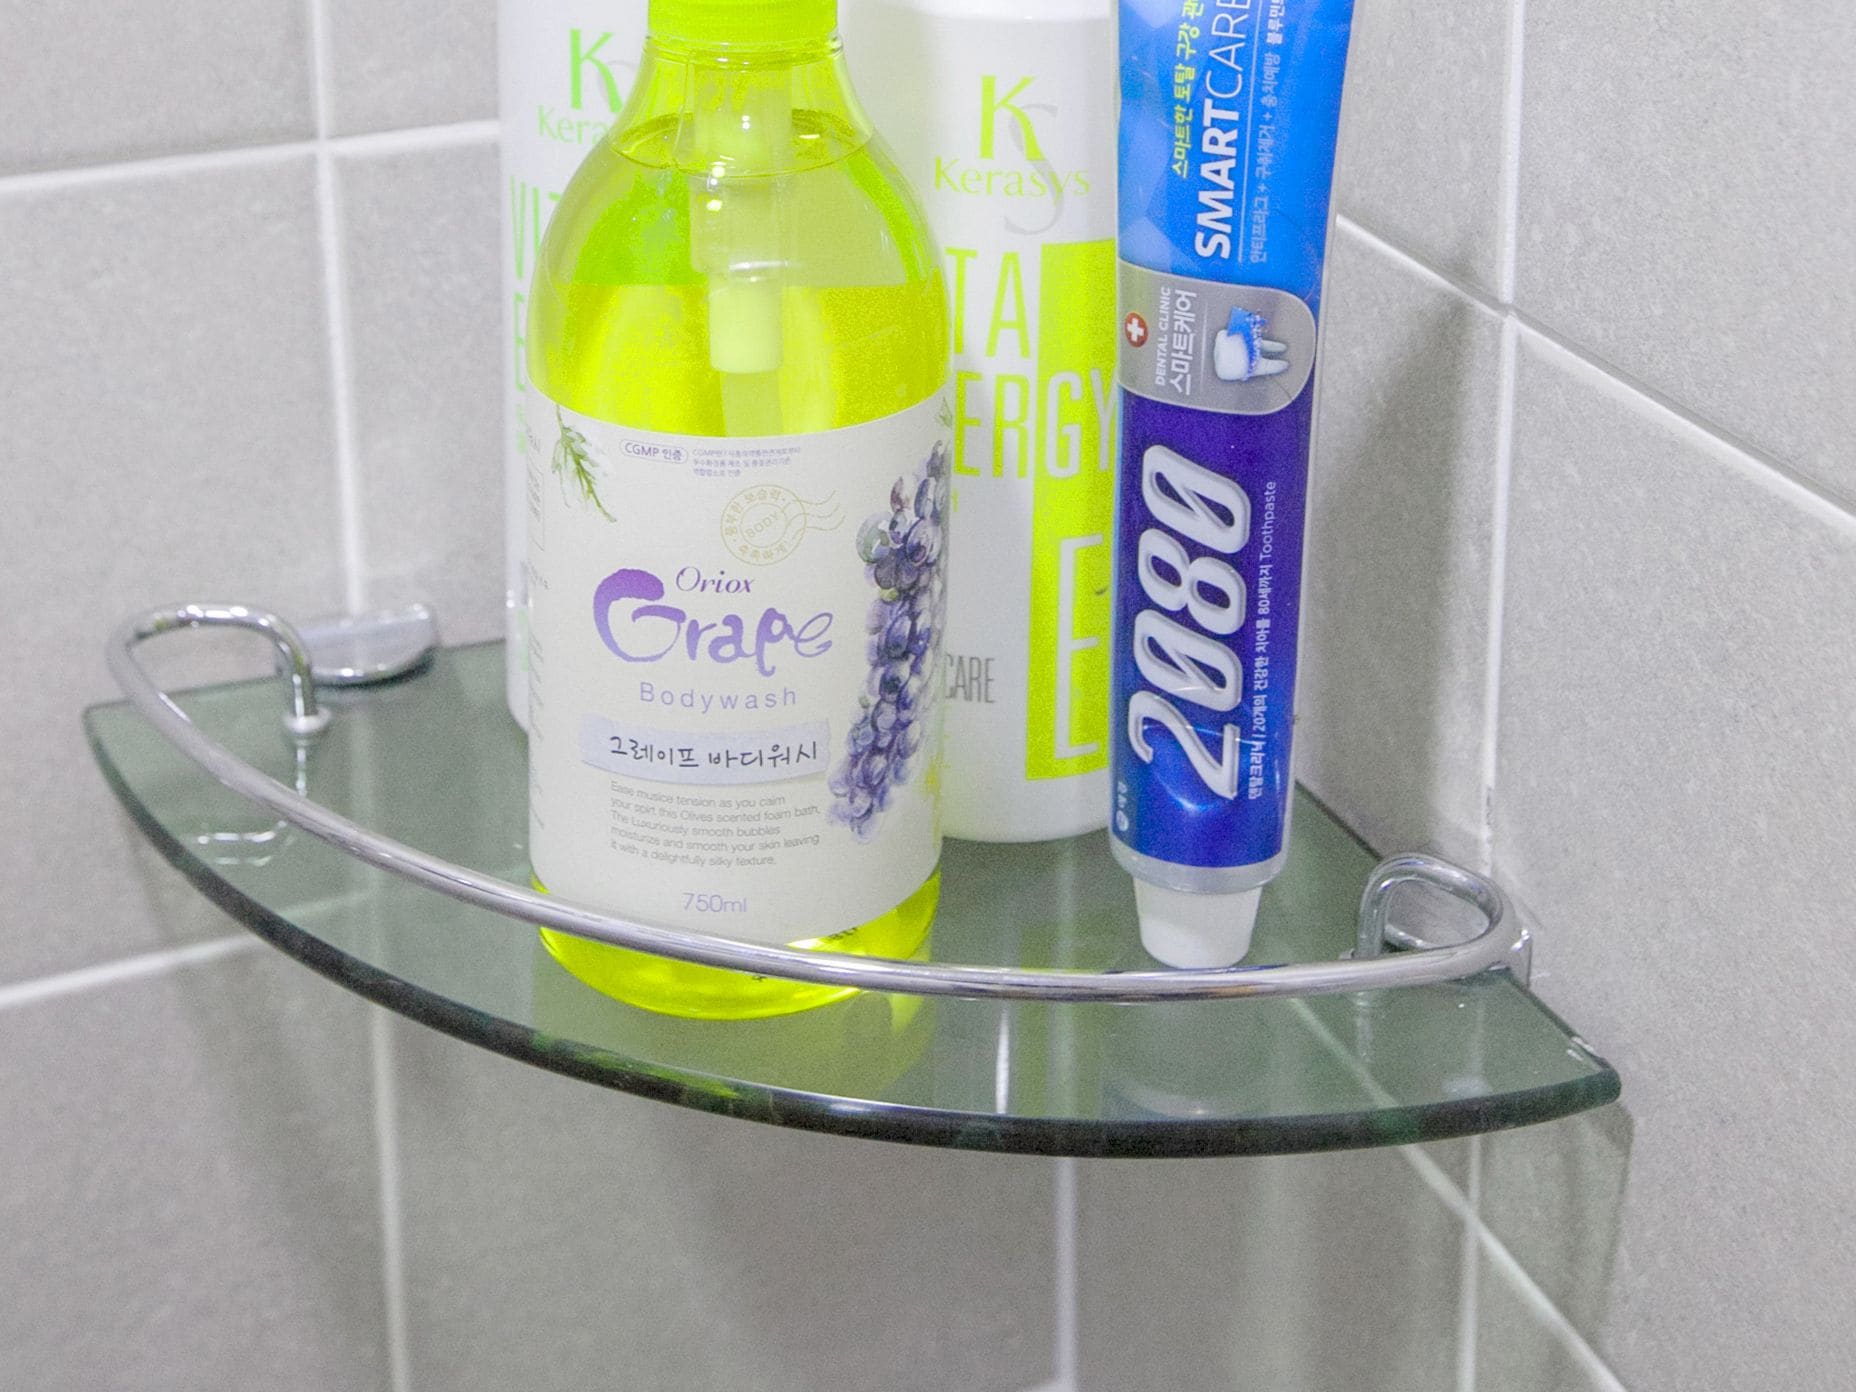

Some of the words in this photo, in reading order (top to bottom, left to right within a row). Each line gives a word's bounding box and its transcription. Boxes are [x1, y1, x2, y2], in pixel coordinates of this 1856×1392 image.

[1176, 22, 1201, 60] 구강
[1174, 63, 1197, 104] 토탈
[538, 104, 608, 146] Kera
[1171, 104, 1194, 180] 스마트한
[934, 156, 1091, 206] Kerasys
[944, 246, 1031, 360] TA
[1159, 287, 1171, 331] CLINIC
[1154, 334, 1169, 386] DENTAL
[1170, 288, 1198, 396] 스마트케어
[954, 368, 1117, 481] ERGY
[624, 442, 660, 458] CGMP
[1260, 481, 1276, 561] Toothpaste
[676, 566, 754, 594] Oriox
[1257, 564, 1273, 616] 80세까지
[593, 568, 833, 677] Grape
[1128, 444, 1252, 800] 2080
[1253, 656, 1270, 691] 건강한
[640, 682, 797, 714] Bodywash
[1252, 694, 1269, 732] 20개의
[609, 735, 700, 768] 그레이프
[708, 741, 817, 768] 바디워시
[735, 799, 757, 810] you
[681, 891, 747, 913] 750ml
